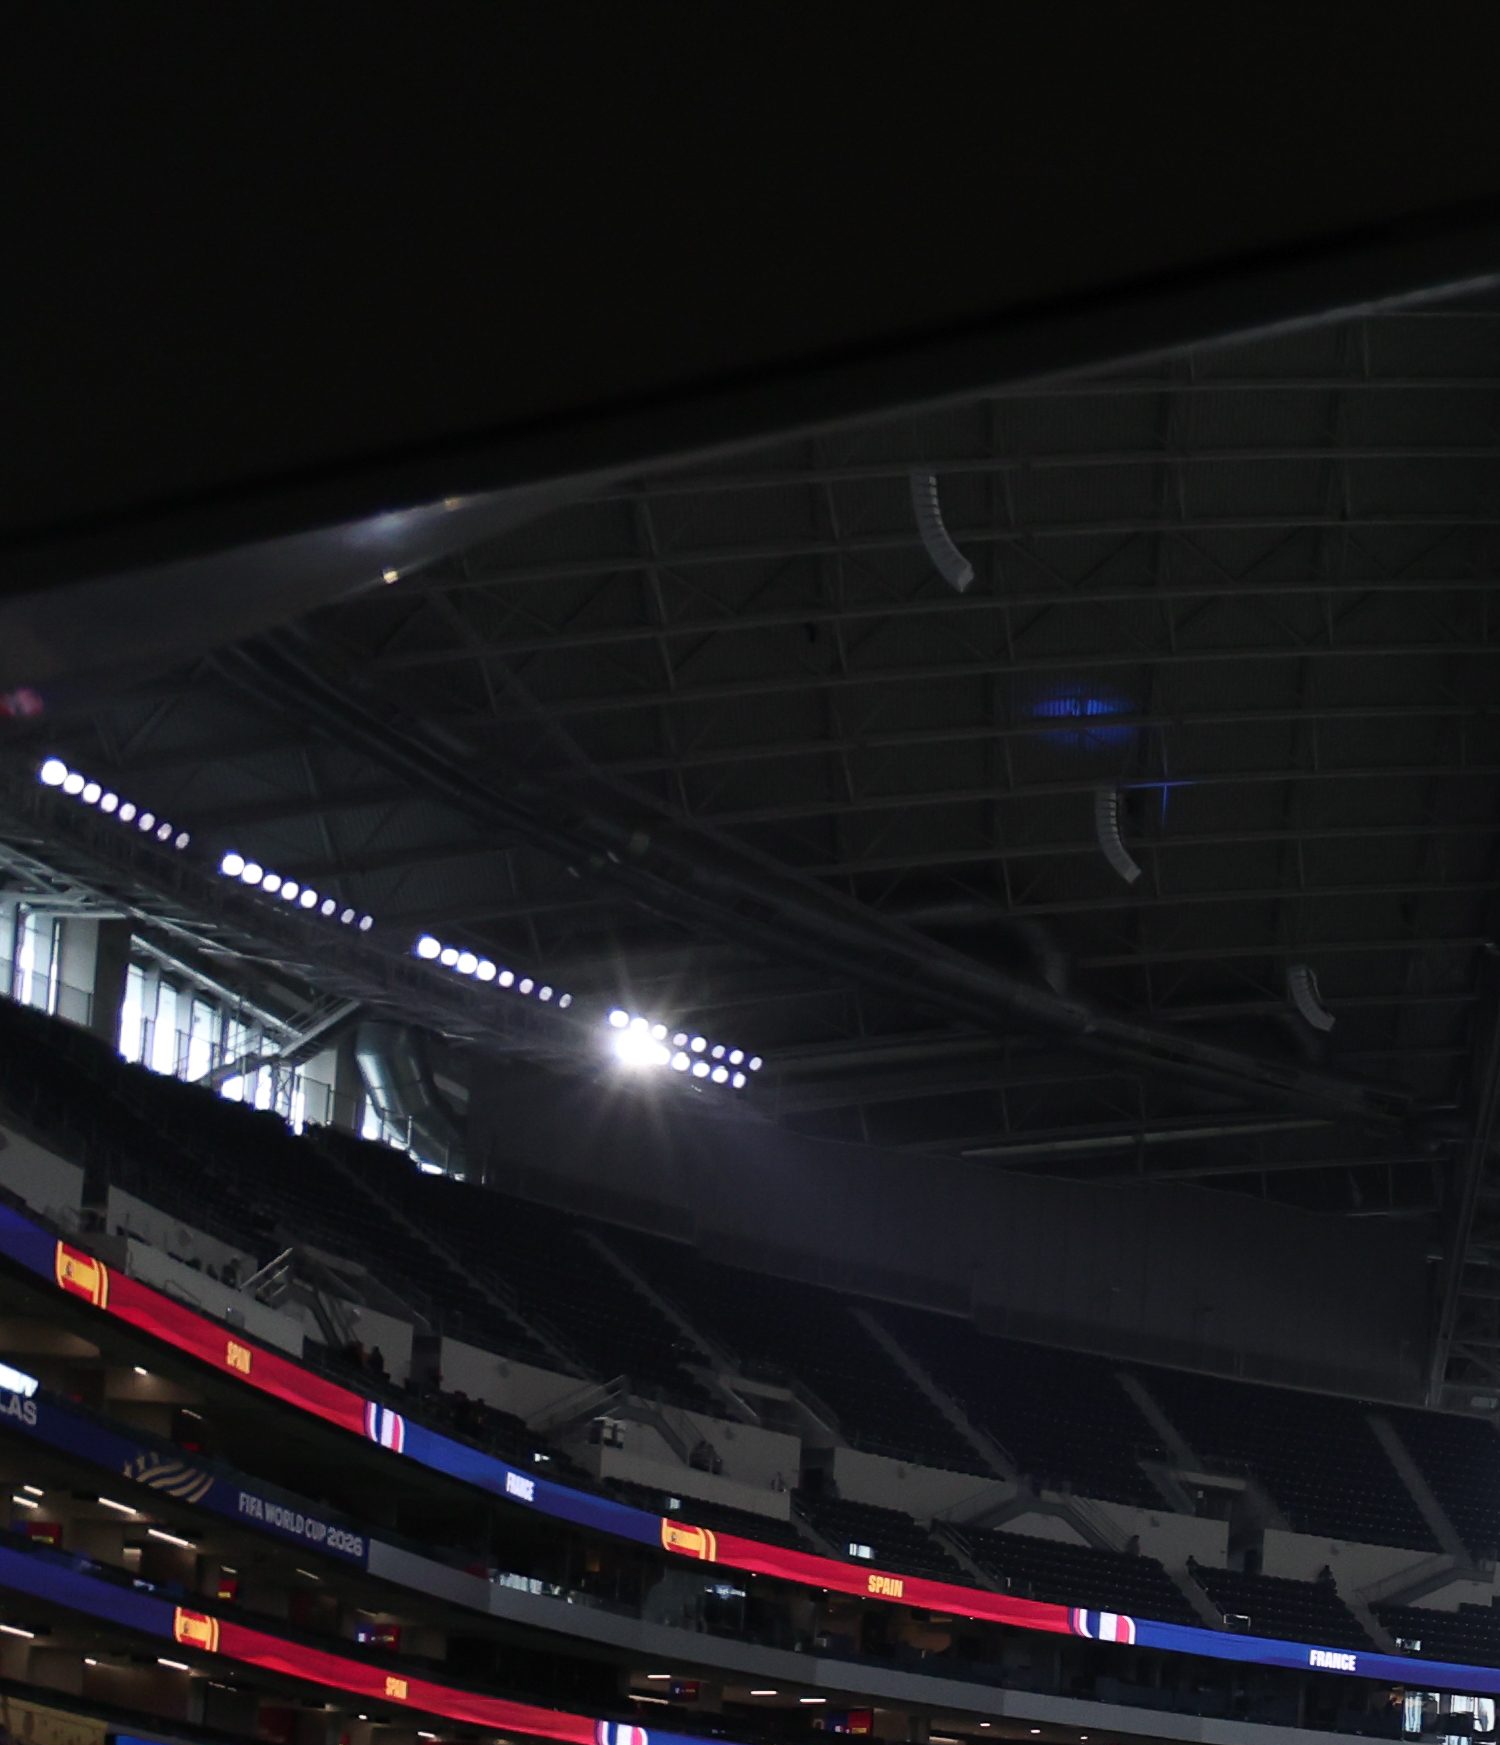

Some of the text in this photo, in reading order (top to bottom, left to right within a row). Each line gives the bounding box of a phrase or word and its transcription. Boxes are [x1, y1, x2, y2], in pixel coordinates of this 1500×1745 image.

[227, 1341, 250, 1374] SPAIN
[239, 1492, 363, 1557] FIFA WORLD CUP 2026
[868, 1575, 903, 1597] SPAIN
[1310, 1650, 1356, 1671] FRANCE
